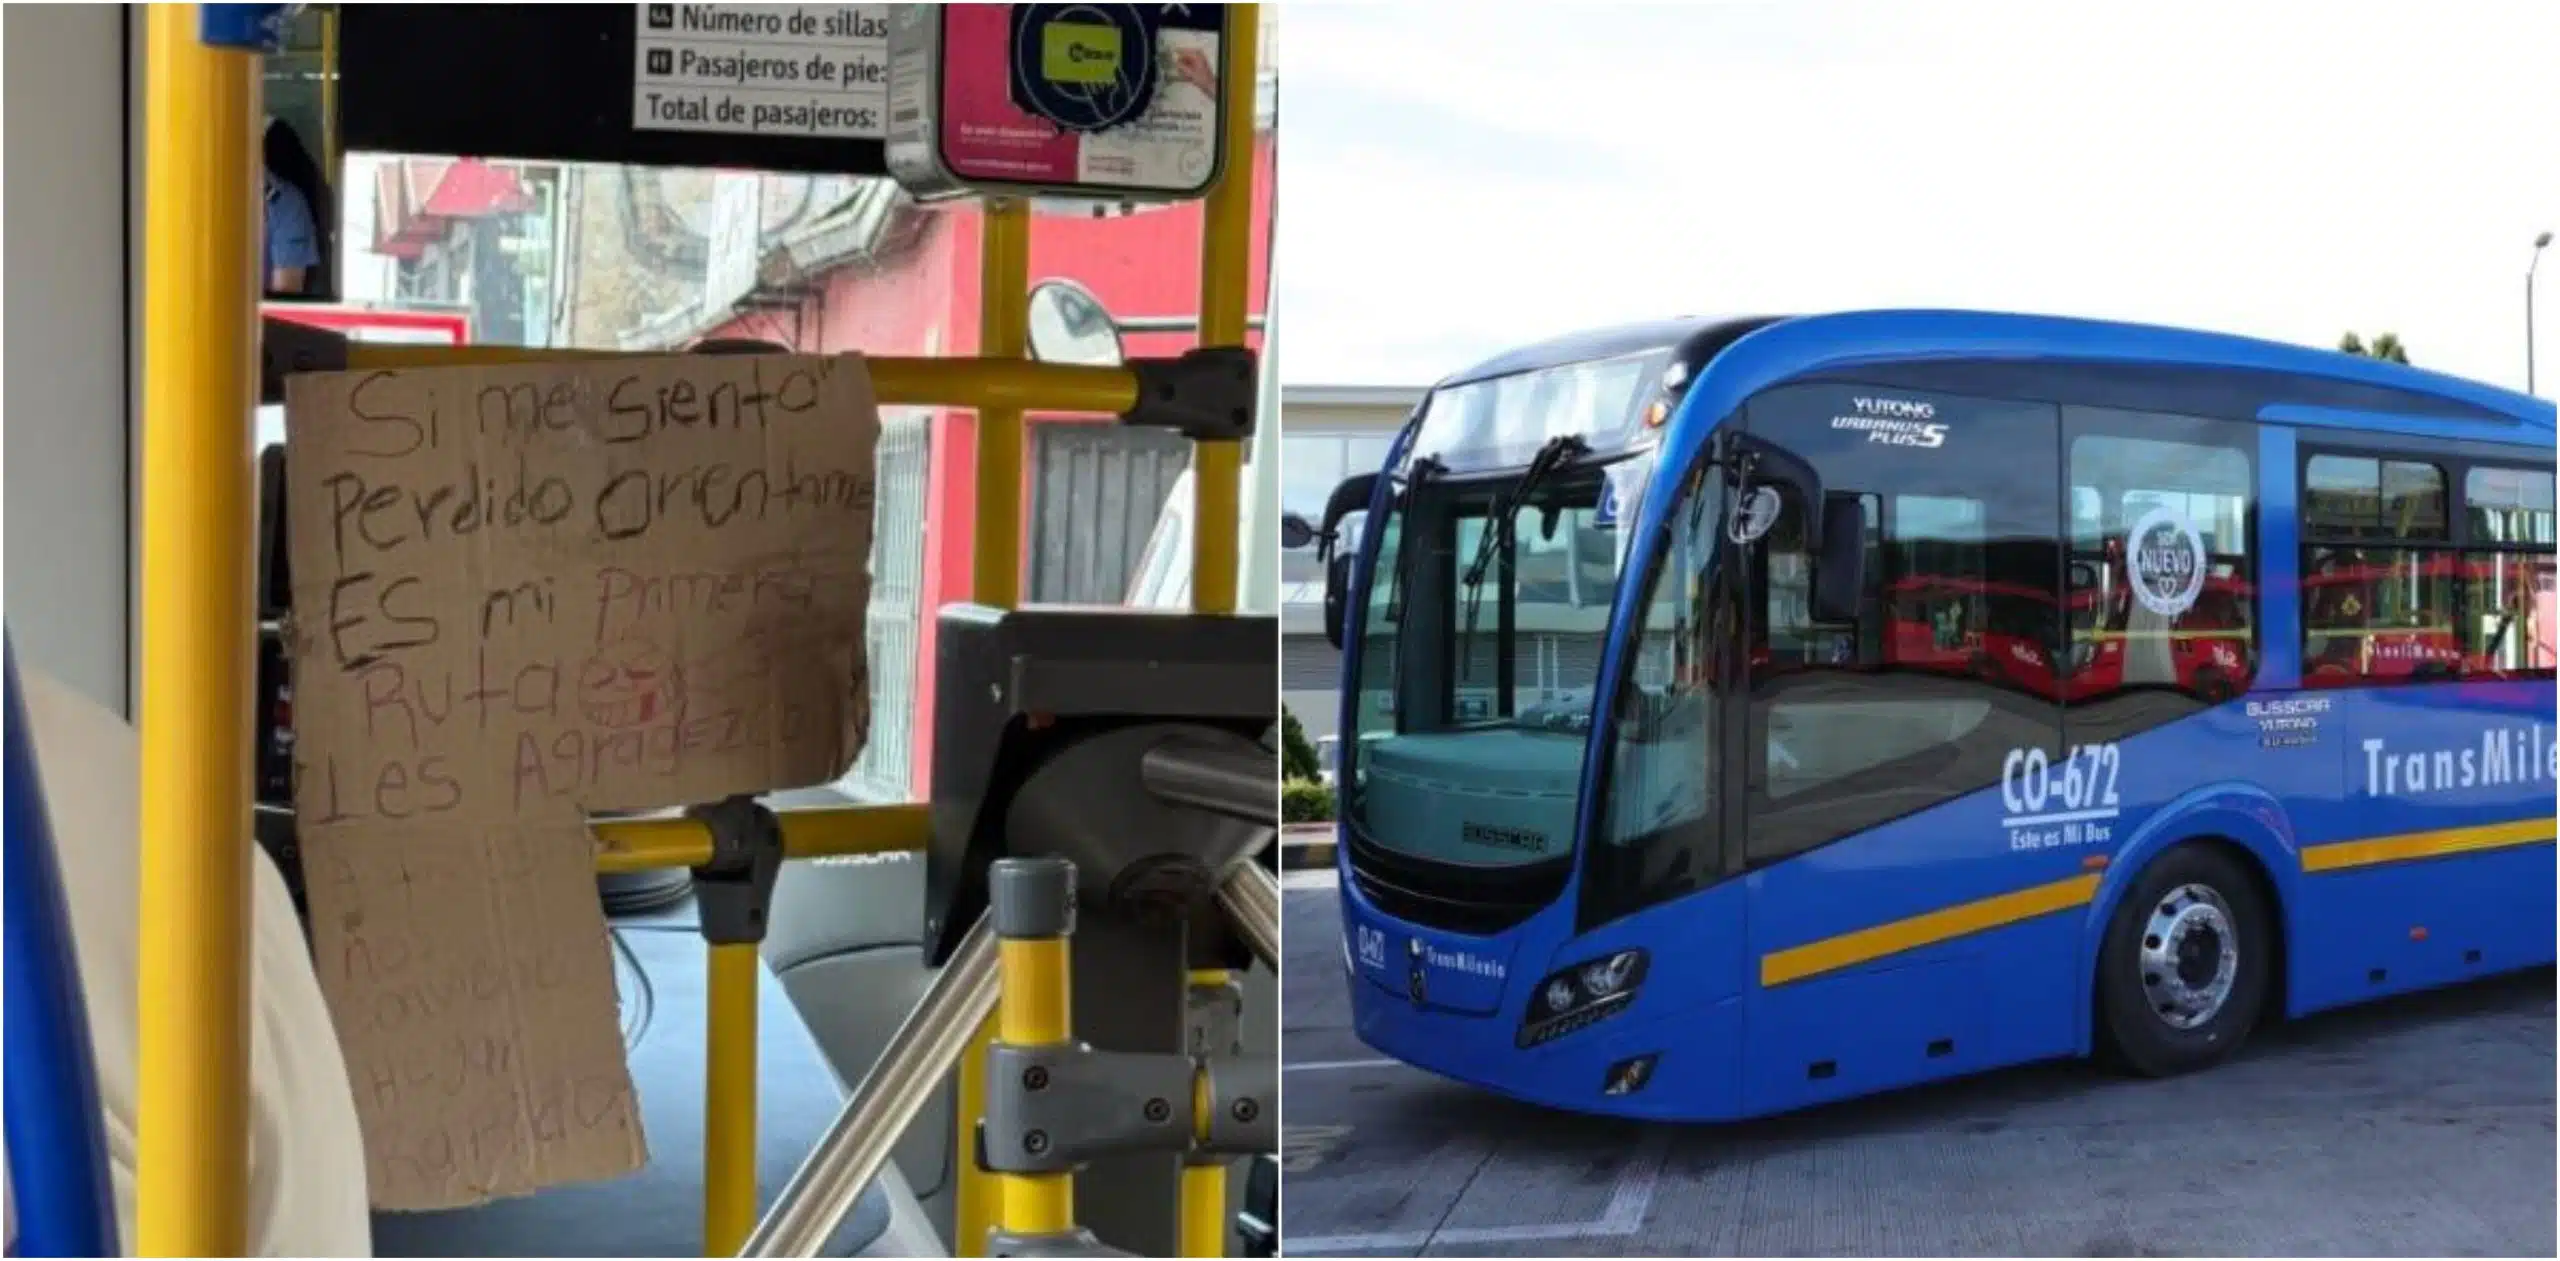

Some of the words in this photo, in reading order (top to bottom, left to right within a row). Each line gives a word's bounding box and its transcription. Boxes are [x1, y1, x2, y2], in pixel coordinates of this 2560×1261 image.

[682, 3, 783, 35] Número
[787, 7, 818, 36] de
[680, 49, 800, 86] Pasajeros
[805, 54, 836, 80] de
[842, 54, 887, 91] pie:
[646, 93, 708, 122] Total
[715, 96, 746, 122] de
[752, 99, 877, 131] pasajeros:
[345, 370, 440, 459] Si
[477, 380, 577, 442] me
[1852, 396, 1936, 419] YUTONG
[2141, 548, 2191, 575] NUEVO
[482, 575, 556, 638] mi
[356, 645, 560, 752] Ruta
[2003, 743, 2120, 813] CO-672
[2010, 829, 2040, 850] Este
[2044, 832, 2061, 847] es
[2064, 823, 2082, 845] Mi
[2086, 822, 2112, 843] Bus
